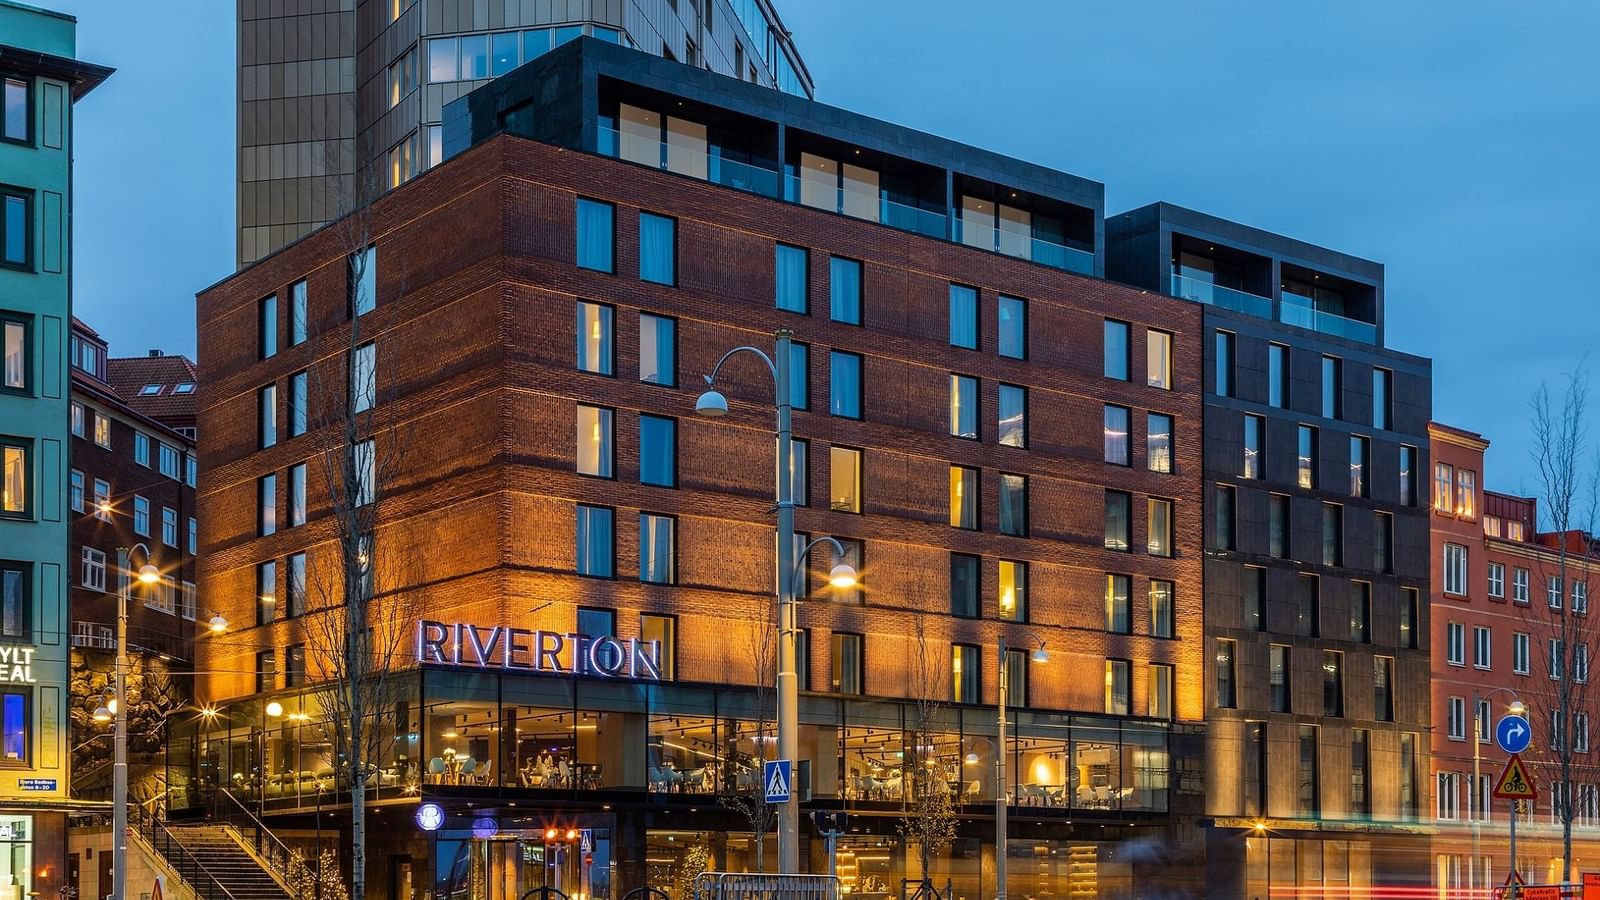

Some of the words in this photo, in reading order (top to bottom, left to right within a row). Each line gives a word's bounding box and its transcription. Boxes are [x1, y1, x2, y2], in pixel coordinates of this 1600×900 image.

[0, 647, 34, 664] YLT
[418, 620, 661, 679] RIVERTON
[0, 664, 36, 682] EAL
